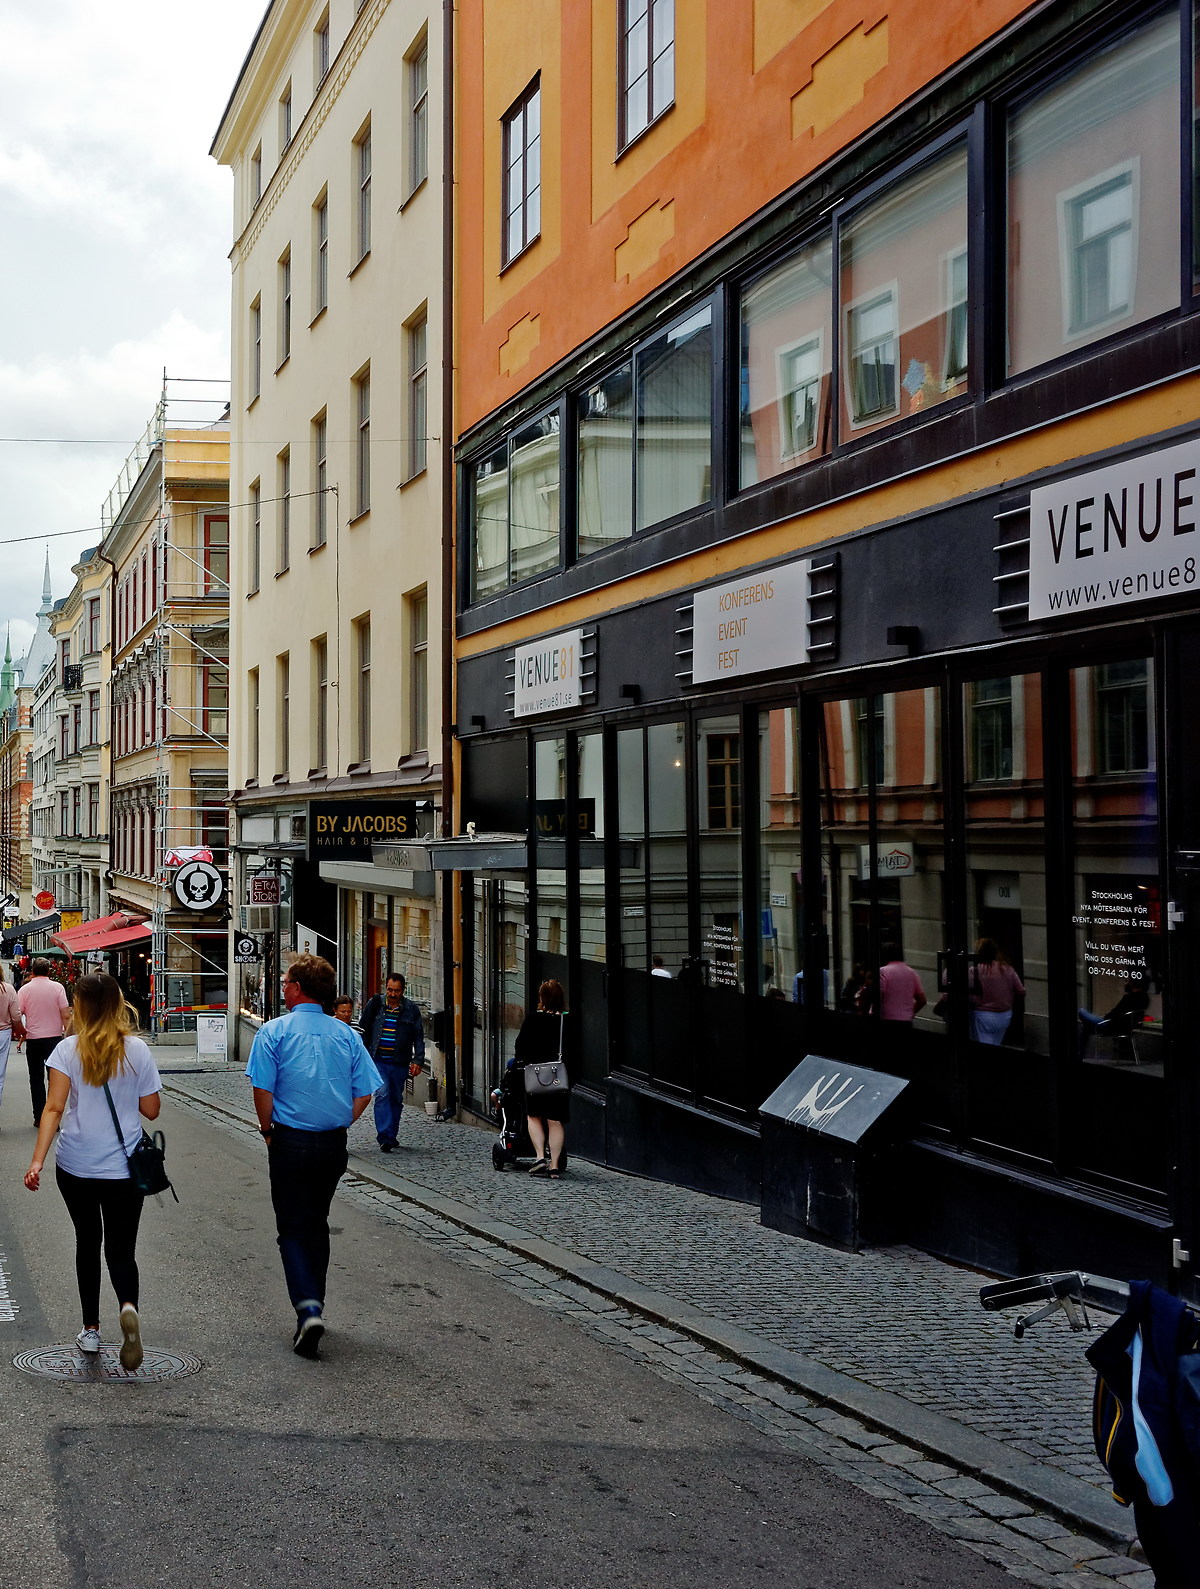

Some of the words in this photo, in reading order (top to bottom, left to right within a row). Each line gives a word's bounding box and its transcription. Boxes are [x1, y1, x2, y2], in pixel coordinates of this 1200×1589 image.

[1047, 468, 1196, 565] VENUE
[719, 580, 774, 612] KONFERENS
[719, 617, 748, 641] EVENT
[718, 649, 740, 670] FEST
[520, 645, 574, 690] VENUE81
[520, 692, 573, 713] www.venue81.se
[317, 815, 338, 833] BY
[343, 815, 408, 833] JACOBS
[318, 837, 343, 846] HAIR
[350, 838, 356, 846] &
[254, 891, 277, 902] STORE
[1092, 891, 1133, 900] STOCKHOLMS
[1093, 903, 1133, 913] MÖTESARENA
[1134, 905, 1147, 914] FÖR
[1072, 916, 1092, 924] EVENT,
[1094, 917, 1130, 927] KONFERENS
[1131, 918, 1137, 927] &
[1139, 920, 1157, 928] FEST.
[1085, 941, 1099, 949] VILL
[1127, 945, 1144, 954] MER?
[1084, 954, 1099, 962] RING
[1115, 956, 1136, 965] GÄRNA
[1137, 957, 1147, 967] PÅ
[1088, 967, 1116, 976] 08-744
[1118, 970, 1129, 978] 30
[1130, 971, 1142, 980] 60
